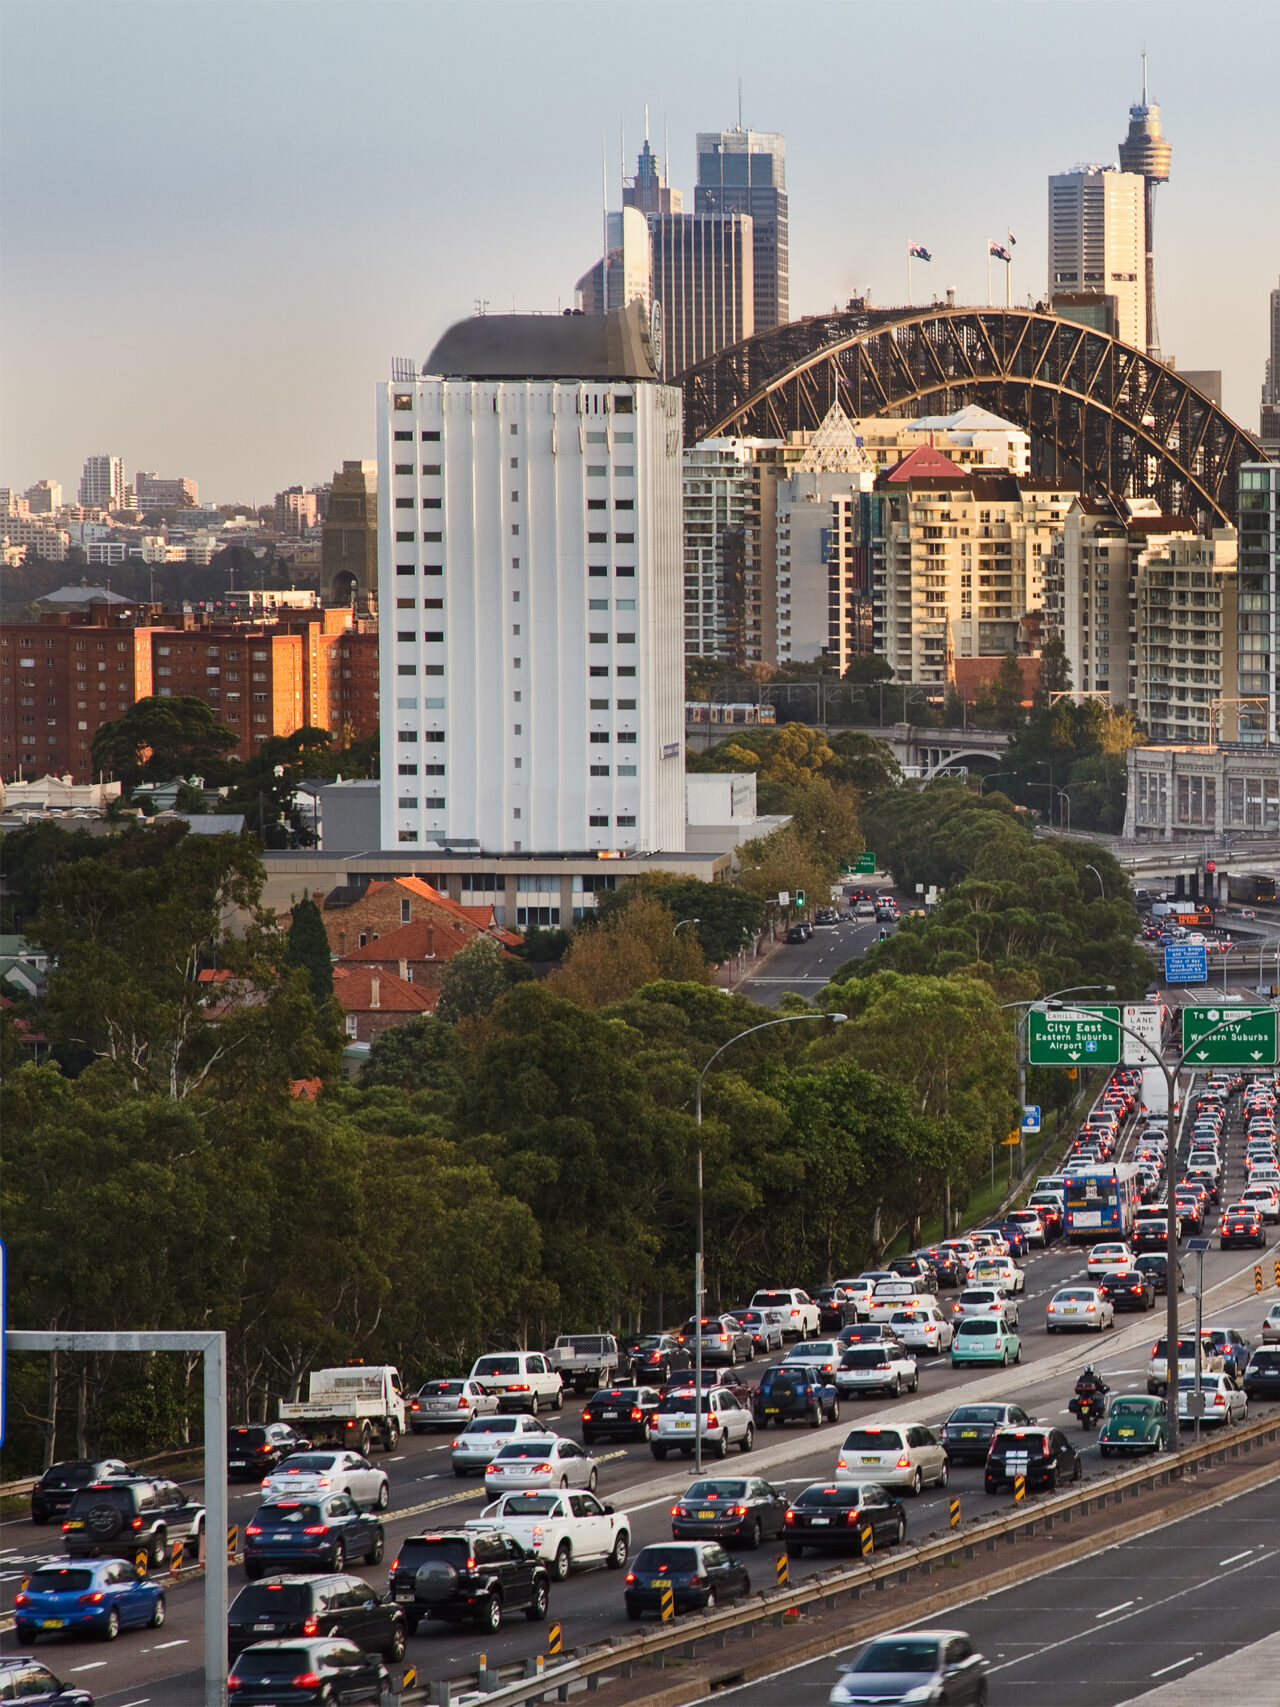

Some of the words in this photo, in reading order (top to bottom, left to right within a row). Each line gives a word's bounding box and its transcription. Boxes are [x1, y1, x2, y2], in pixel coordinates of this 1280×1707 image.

[1047, 1023, 1071, 1033] City
[1077, 1023, 1102, 1032] East
[1049, 1042, 1082, 1050] Airport
